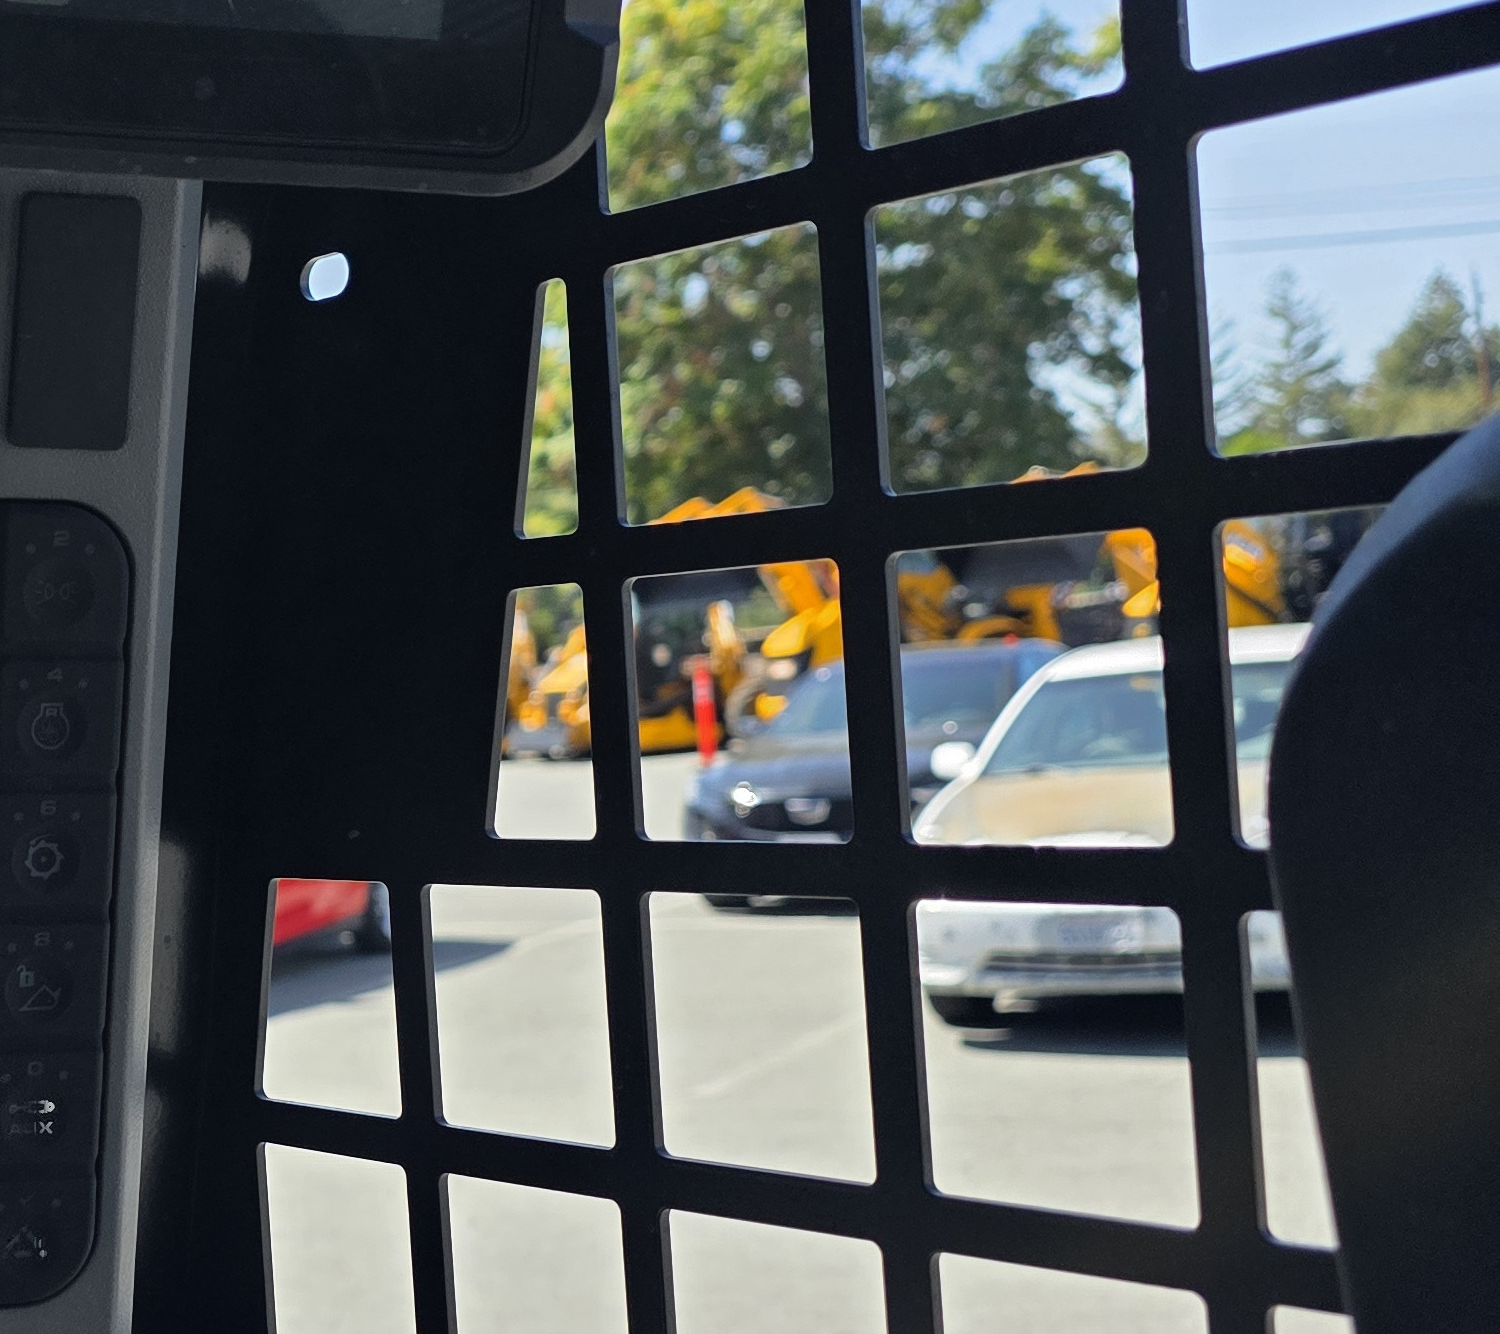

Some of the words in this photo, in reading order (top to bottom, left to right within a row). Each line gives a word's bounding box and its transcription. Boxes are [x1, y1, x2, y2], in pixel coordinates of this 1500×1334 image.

[53, 530, 71, 546] 2
[47, 667, 63, 681] 4
[40, 800, 57, 815] 6
